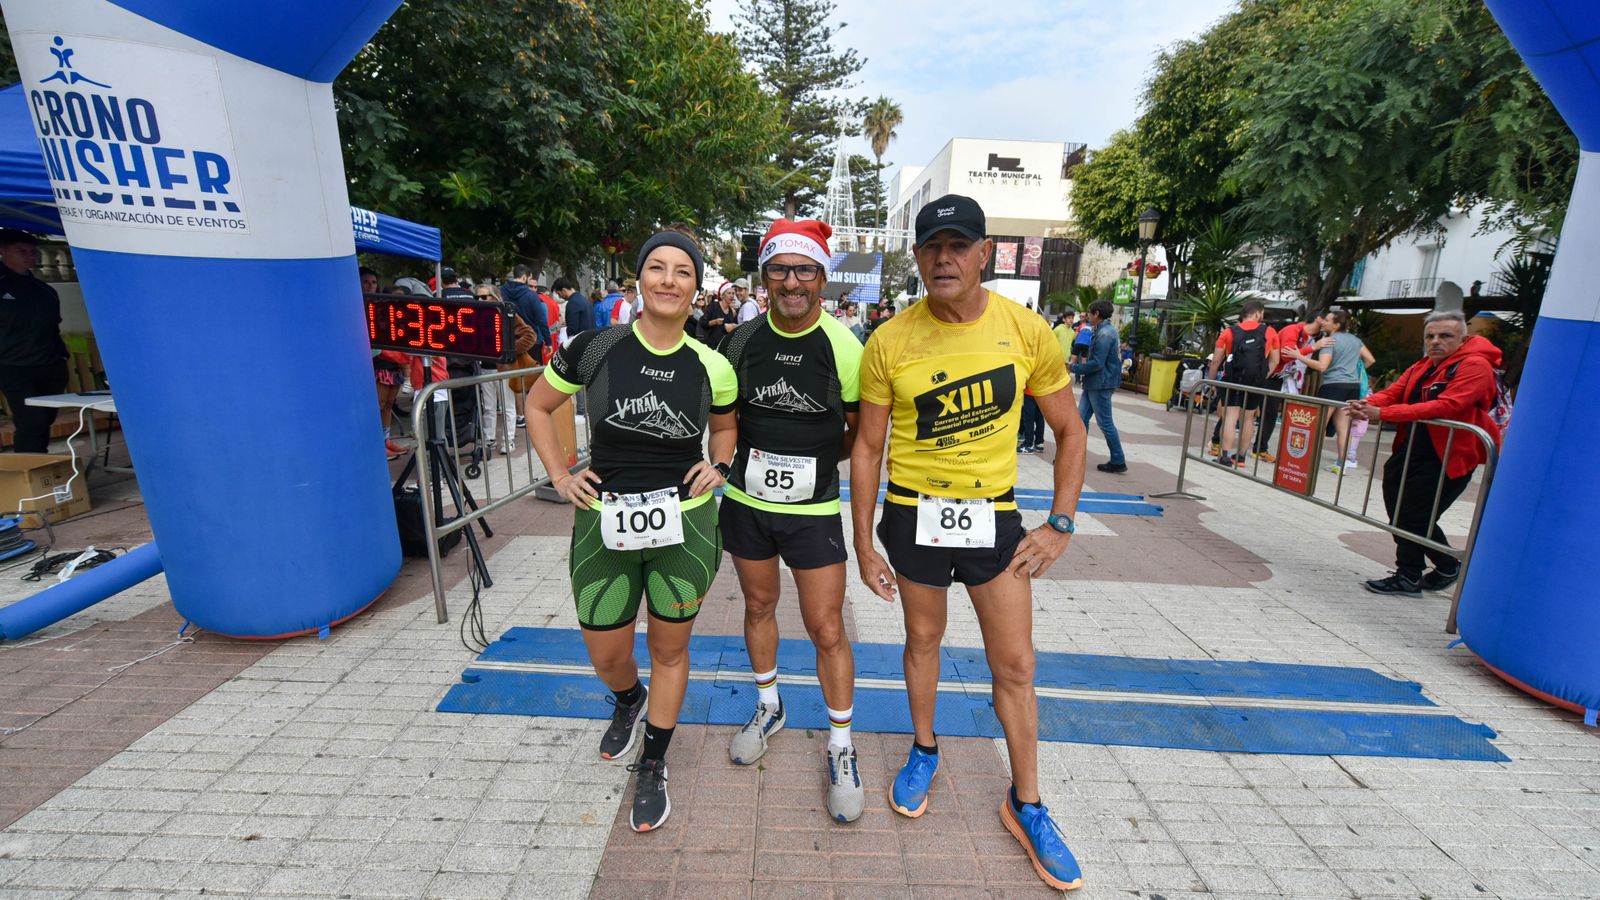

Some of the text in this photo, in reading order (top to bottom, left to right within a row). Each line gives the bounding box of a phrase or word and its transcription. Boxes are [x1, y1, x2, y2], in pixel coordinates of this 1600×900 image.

[30, 90, 161, 145] CRONO
[968, 170, 1042, 180] TEATRO MUNICIPAL
[77, 207, 83, 218] Y
[86, 209, 165, 225] ORGANIZACIÓN
[167, 215, 184, 226] DE
[187, 216, 246, 229] EVENTOS
[350, 206, 379, 234] HER
[780, 239, 816, 253] TOMAX
[828, 271, 843, 282] SAN
[775, 352, 803, 363] land
[640, 365, 675, 379] land
[935, 379, 994, 417] XIII
[615, 395, 661, 419] V-TRAIL
[960, 412, 971, 420] del
[931, 421, 962, 433] Memorial
[962, 417, 979, 425] Pepe
[969, 424, 995, 438] TARIFA
[936, 437, 943, 447] 4
[764, 468, 794, 490] 85
[616, 507, 666, 533] 100
[940, 507, 972, 530] 86
